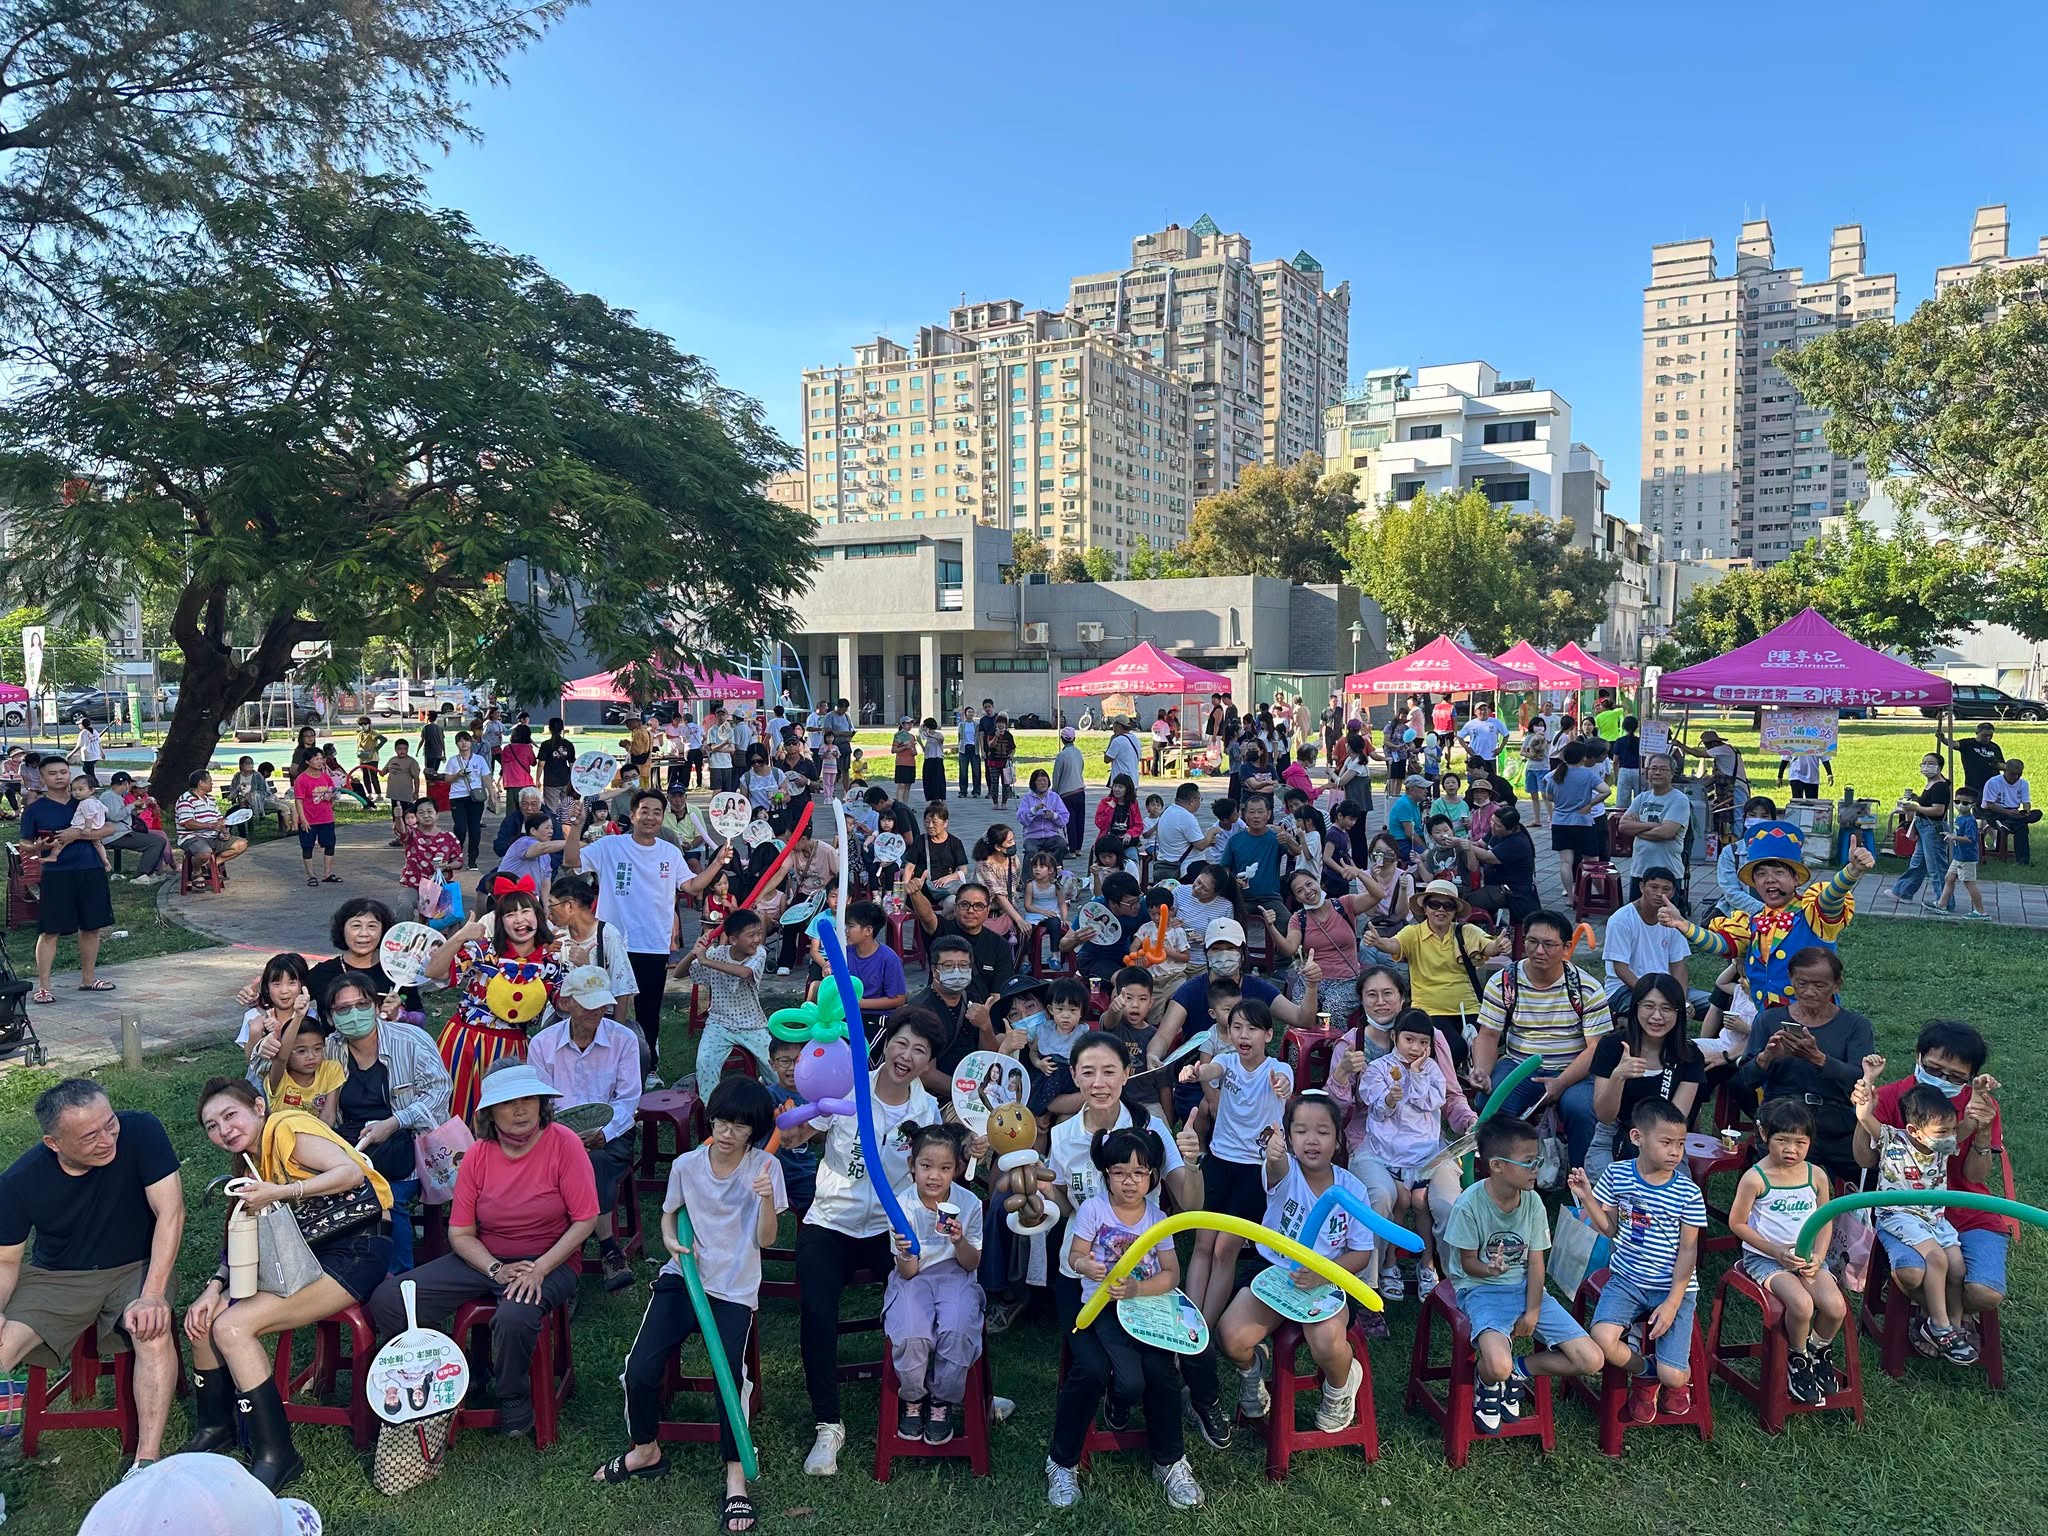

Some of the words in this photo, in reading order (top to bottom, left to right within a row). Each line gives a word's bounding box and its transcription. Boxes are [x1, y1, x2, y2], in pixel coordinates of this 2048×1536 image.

[1767, 649, 1842, 663] 陳亭妃
[1719, 687, 1817, 701] 國會評鑑第一名
[1822, 687, 1886, 706] 陳亭妃
